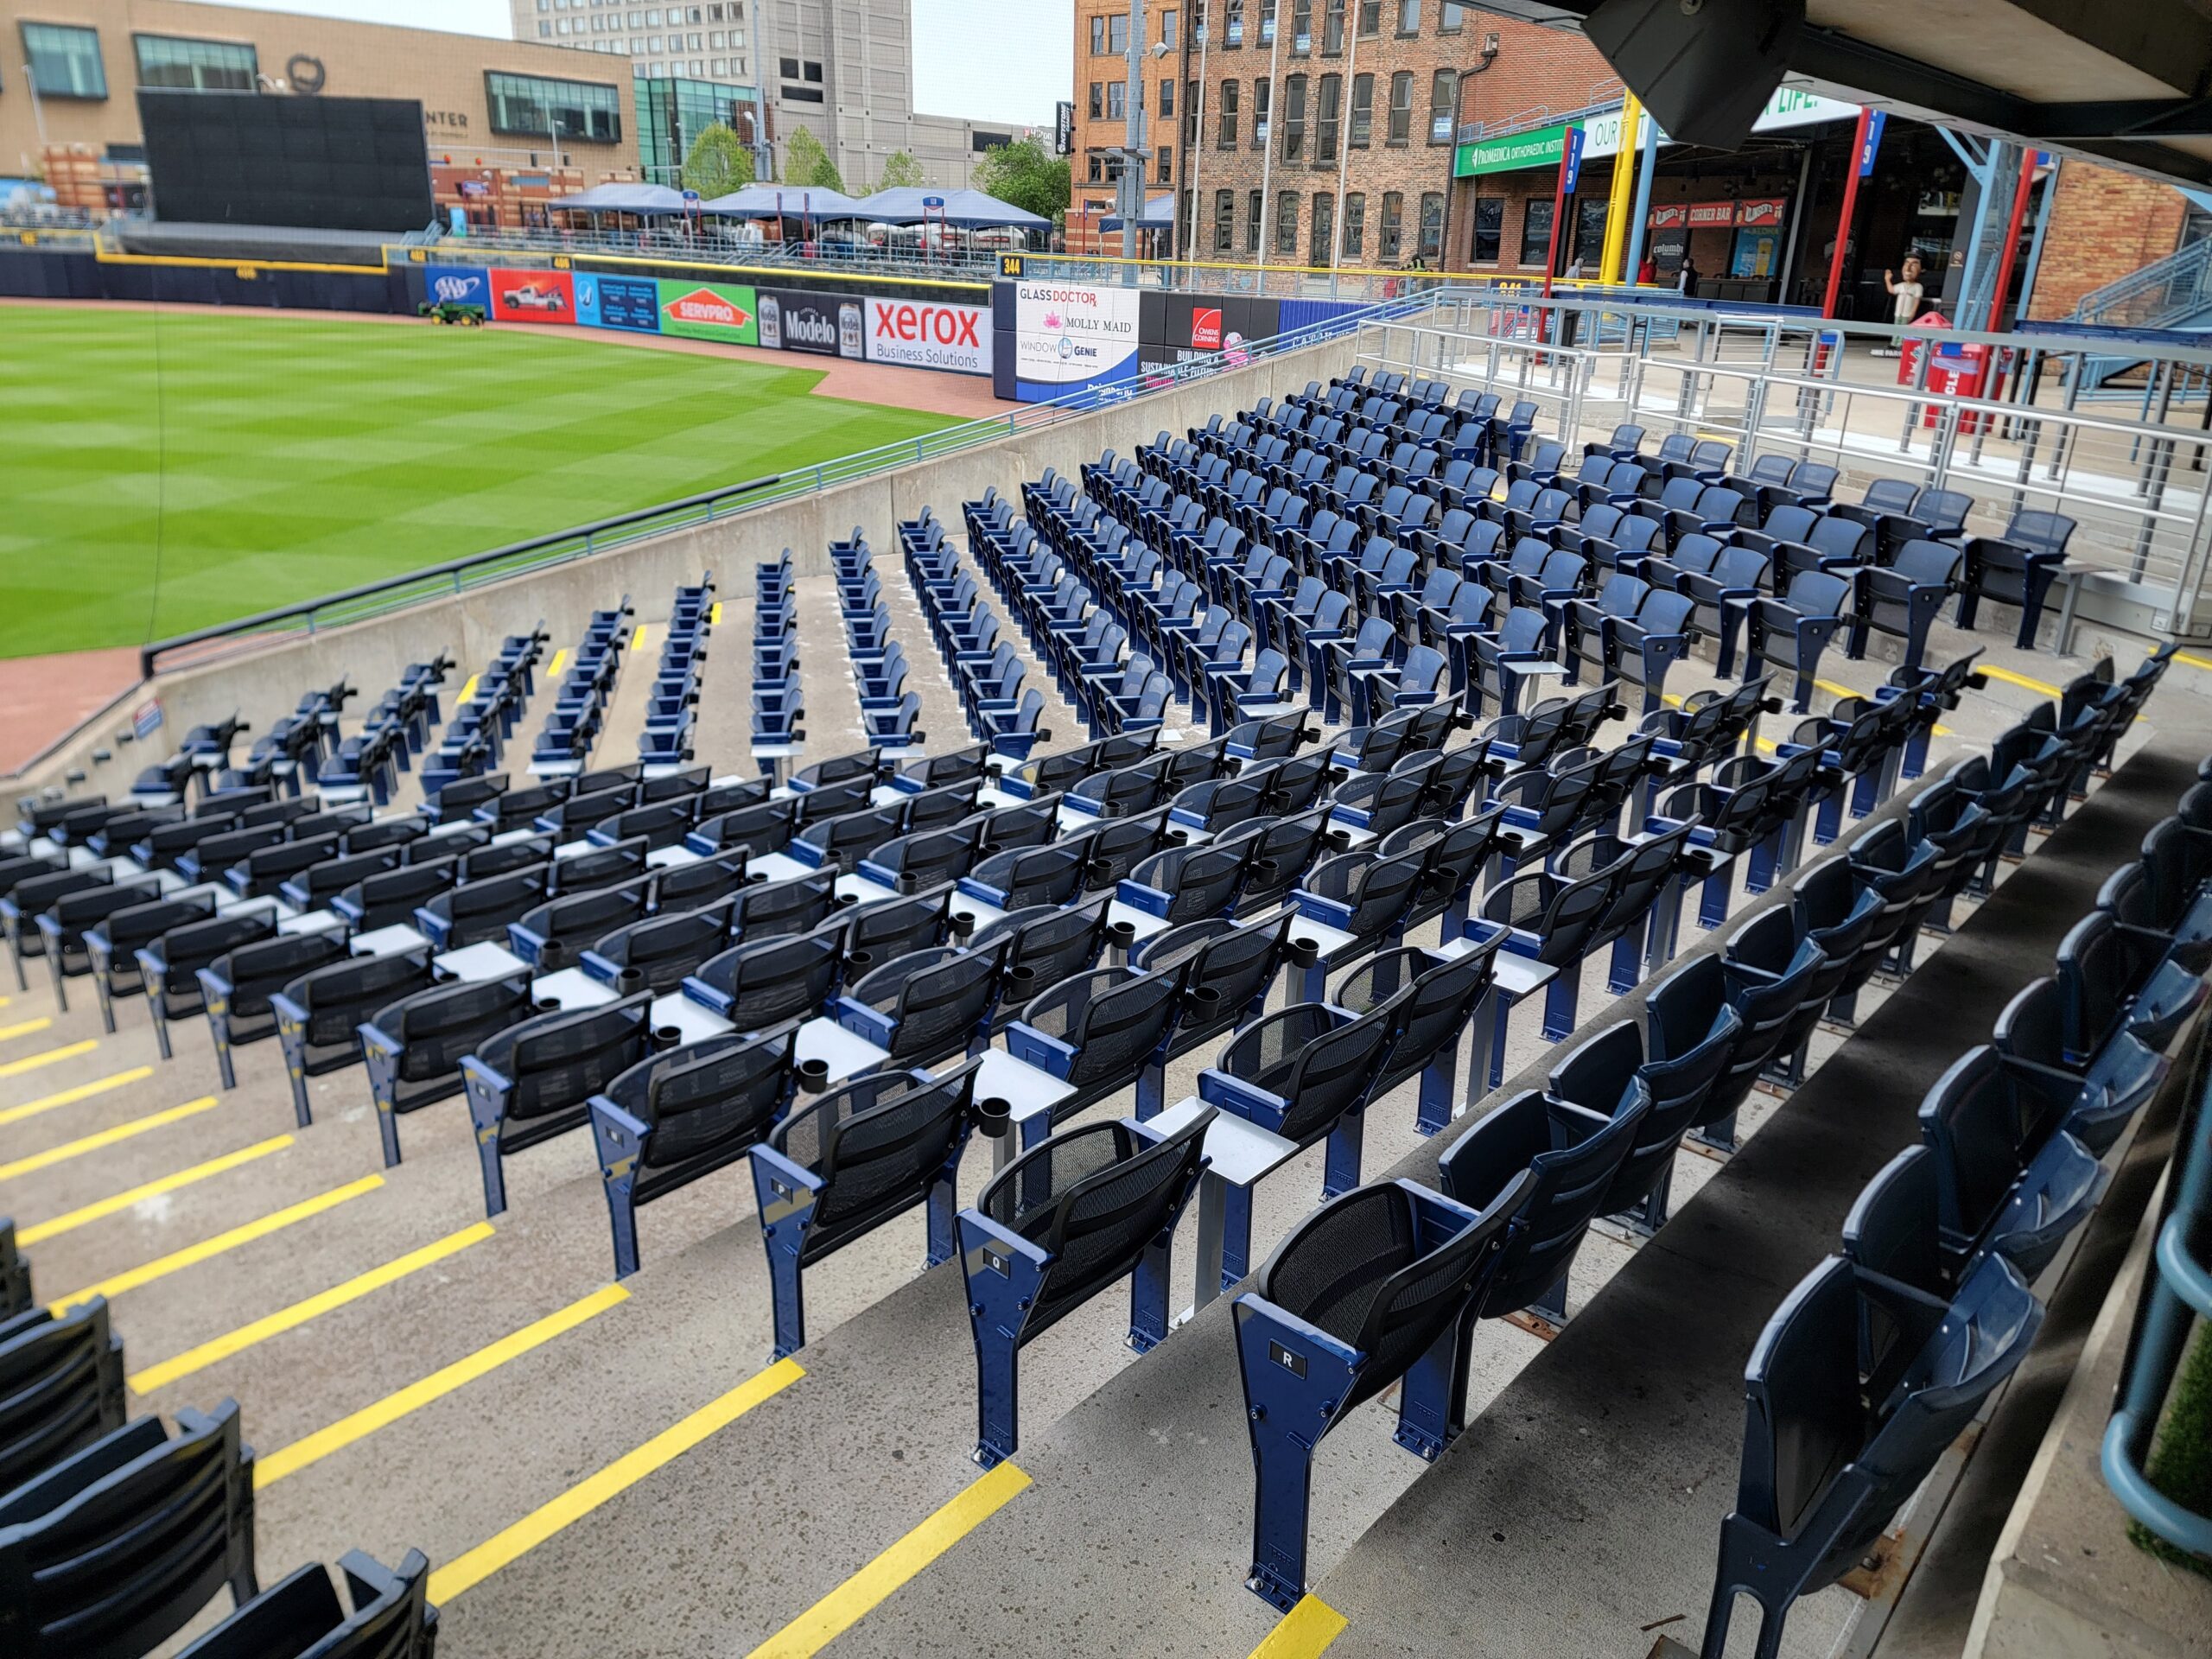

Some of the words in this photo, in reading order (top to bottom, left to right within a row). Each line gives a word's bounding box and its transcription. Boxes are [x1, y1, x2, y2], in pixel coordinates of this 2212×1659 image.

[426, 111, 467, 128] NTER
[1595, 120, 1618, 147] OUR
[1511, 142, 1545, 159] ORTHOPAEDIC
[1567, 135, 1578, 185] 119
[1690, 207, 1715, 222] CORNER
[1716, 207, 1731, 220] BAR
[1004, 257, 1020, 275] 344
[679, 301, 733, 322] SERVPRO
[785, 309, 836, 345] Modelo
[875, 303, 980, 348] xerox
[1066, 317, 1099, 330] MOLLY
[1103, 321, 1131, 334] MAID
[1198, 327, 1219, 335] OWENS
[1194, 334, 1218, 343] CORNING
[877, 343, 923, 362] Business
[925, 348, 978, 368] Solutions
[1020, 340, 1057, 353] WINDOW
[1074, 345, 1097, 357] GENIE
[778, 1184, 785, 1194] P
[993, 1256, 1001, 1270] Q
[1282, 1351, 1294, 1368] R
